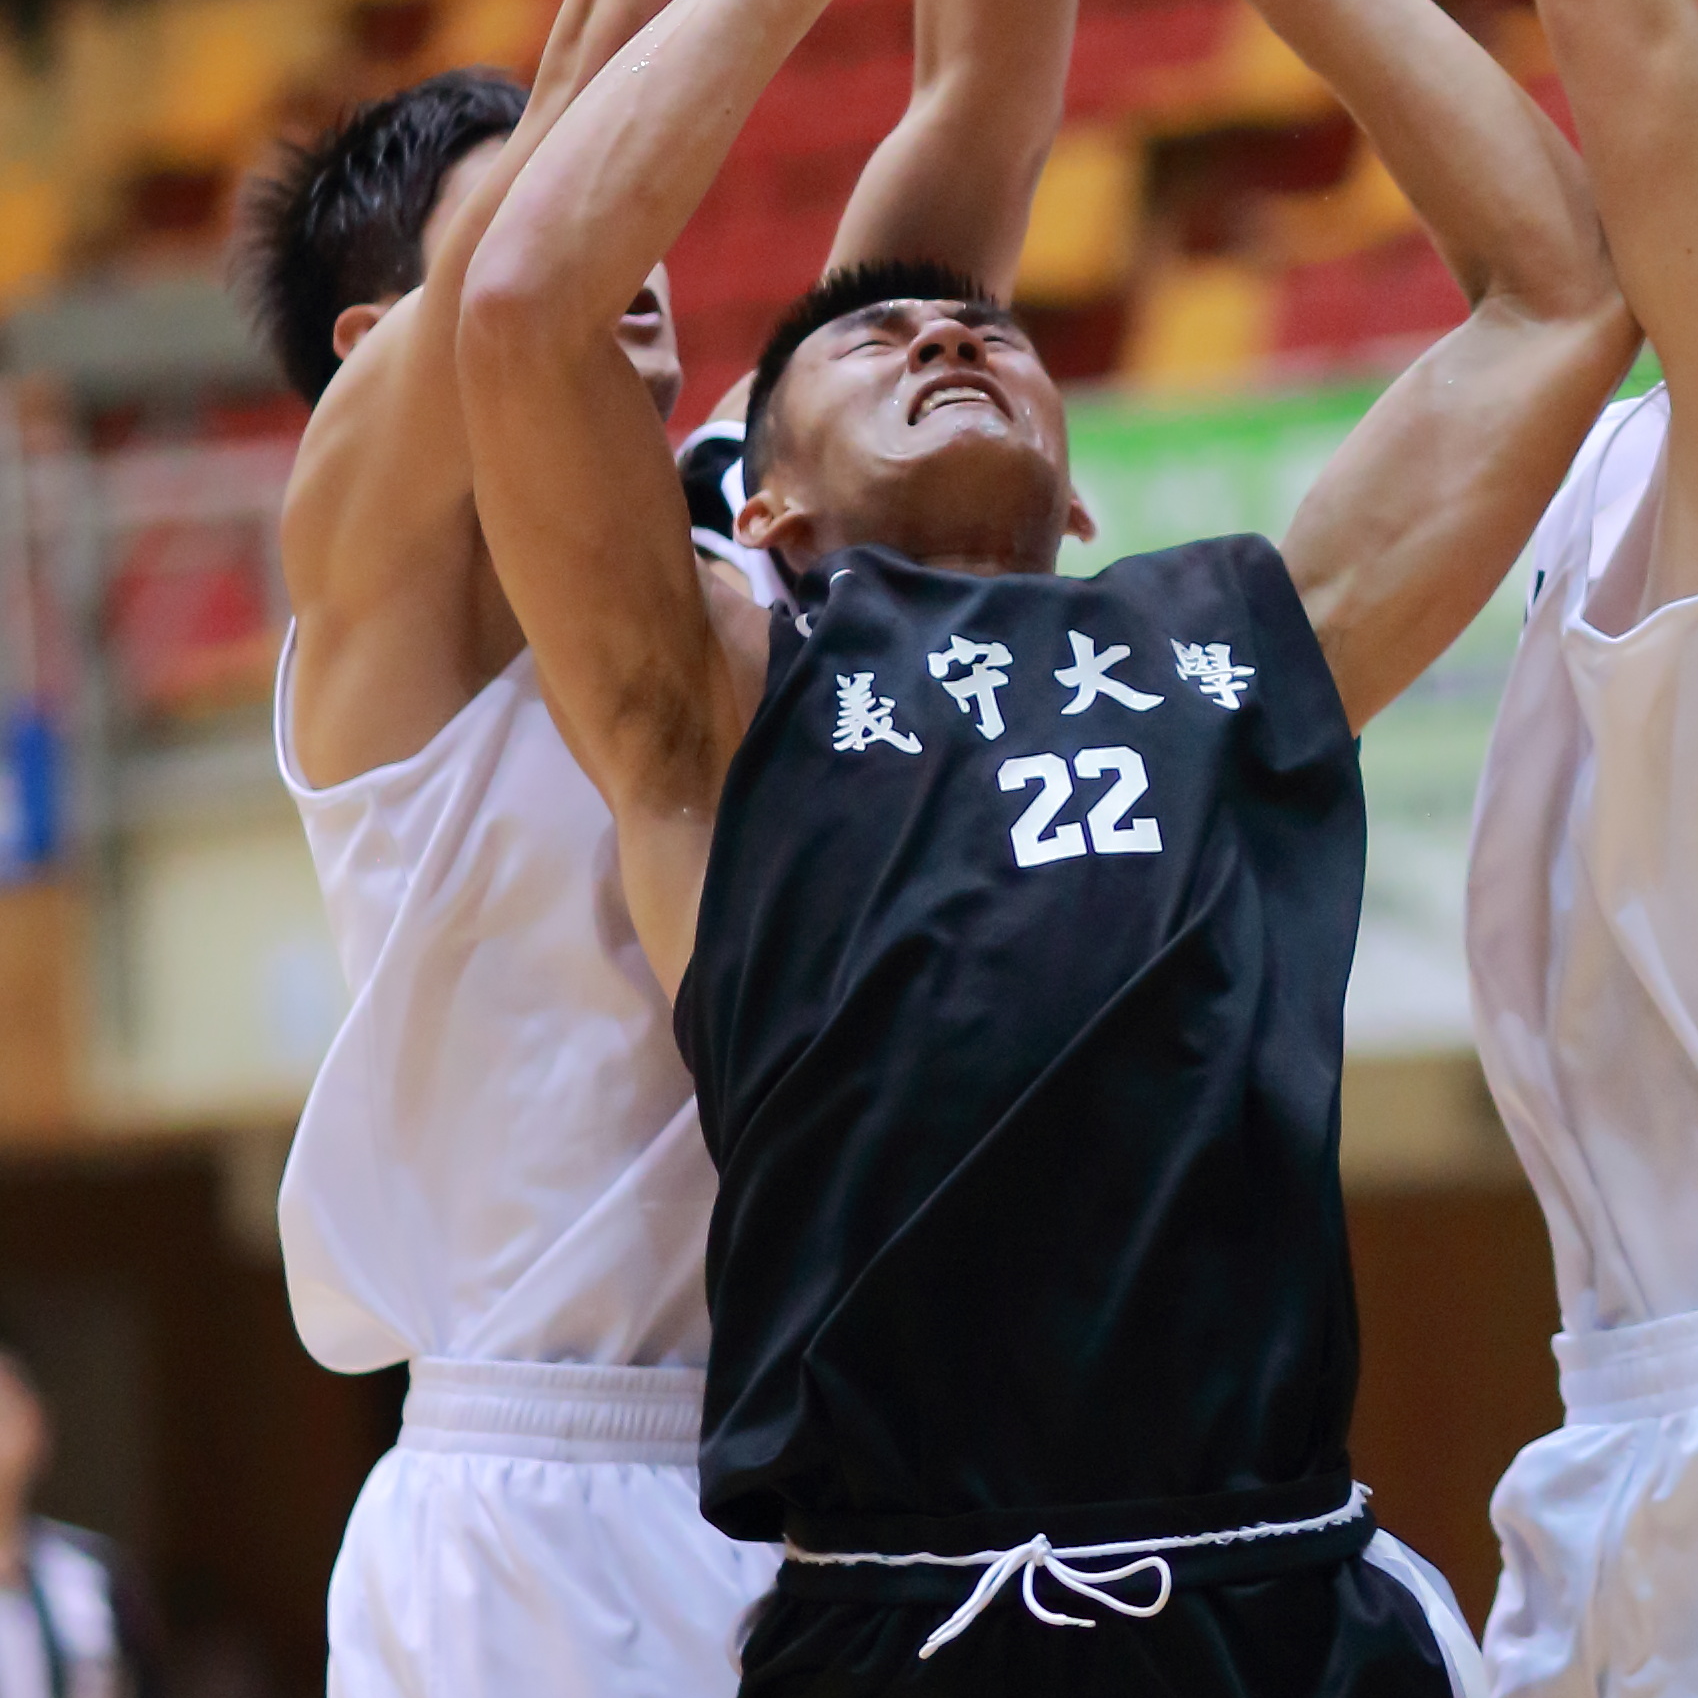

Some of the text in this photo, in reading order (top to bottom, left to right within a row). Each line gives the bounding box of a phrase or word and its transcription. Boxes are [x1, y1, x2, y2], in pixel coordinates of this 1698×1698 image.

[832, 629, 1256, 755] 義守大學
[996, 745, 1164, 869] 22
